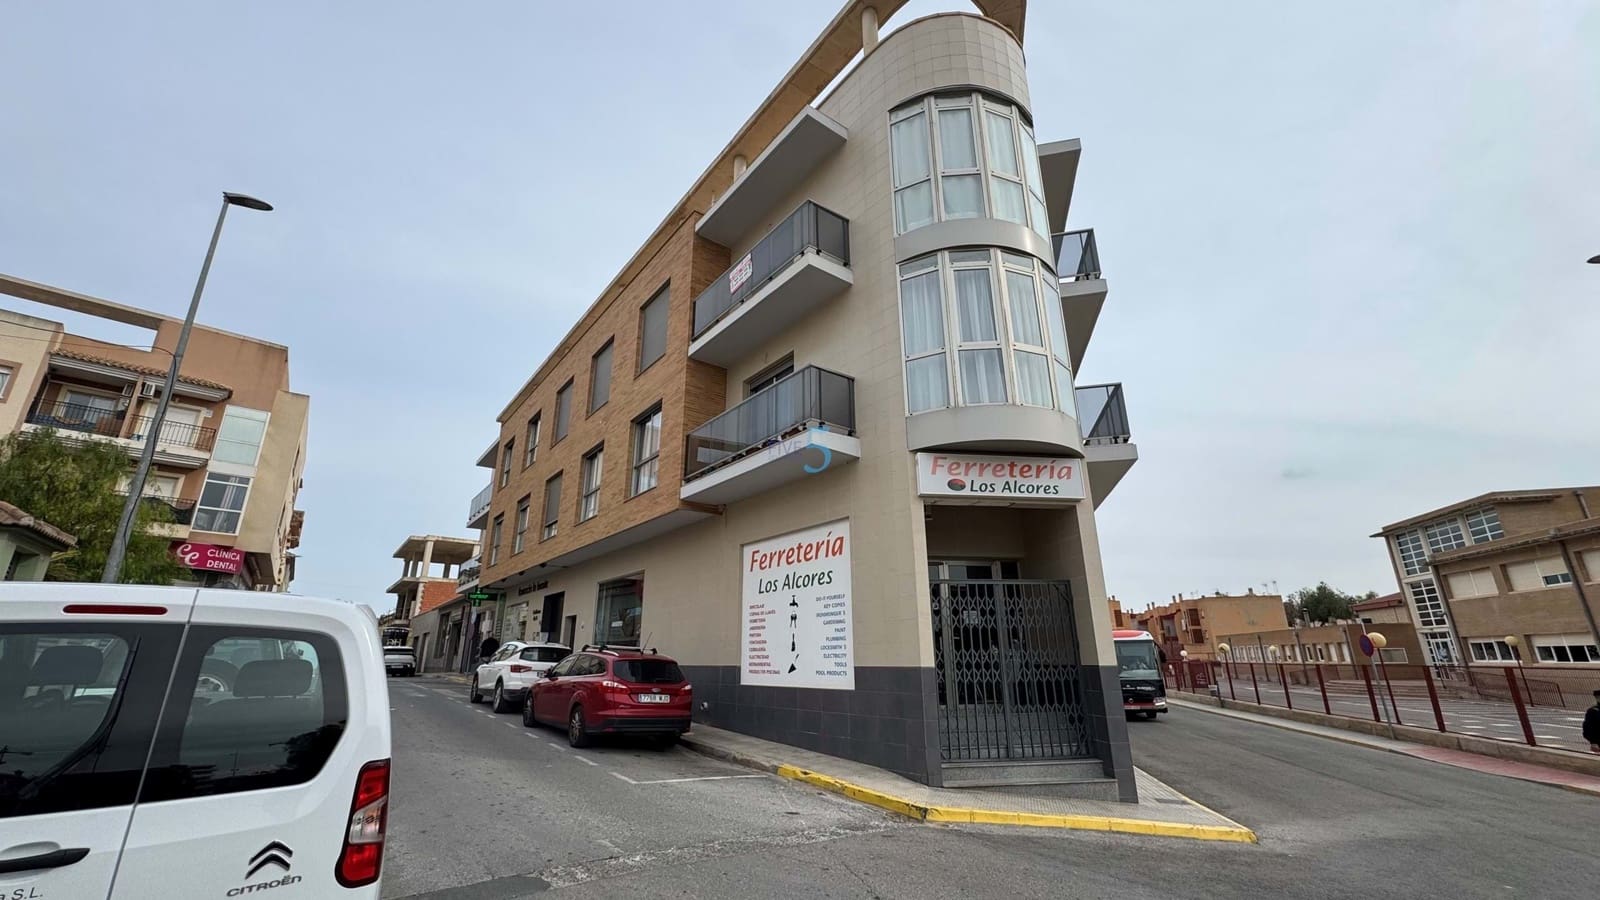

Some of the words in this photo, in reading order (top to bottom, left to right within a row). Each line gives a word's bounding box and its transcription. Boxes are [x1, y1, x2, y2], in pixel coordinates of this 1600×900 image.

[930, 455, 1073, 480] Ferretería
[970, 479, 996, 493] Los
[1001, 480, 1060, 495] Alcores
[207, 548, 240, 561] CLÍNICA
[750, 531, 845, 572] Ferretería
[206, 559, 236, 571] DENTAL
[758, 578, 778, 594] Los
[782, 570, 833, 591] Alcores
[11, 886, 43, 900] S.L.
